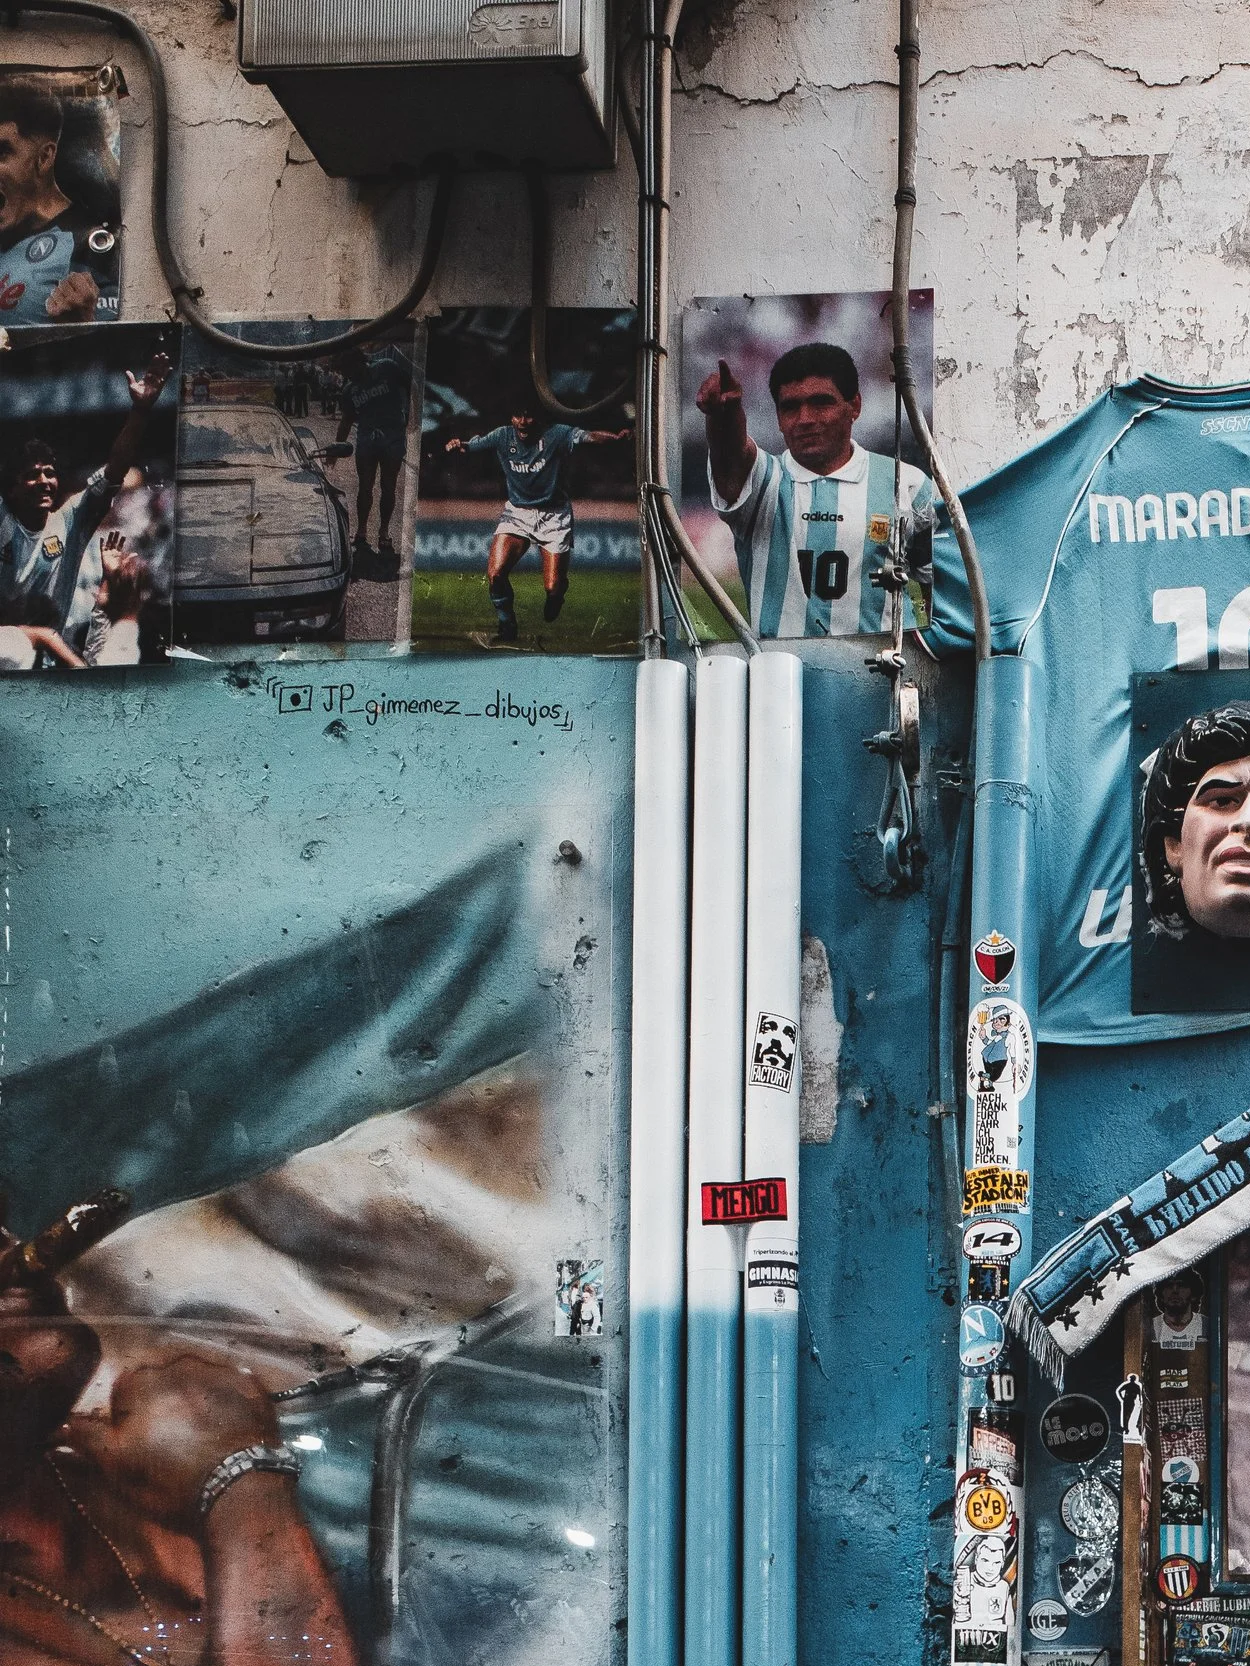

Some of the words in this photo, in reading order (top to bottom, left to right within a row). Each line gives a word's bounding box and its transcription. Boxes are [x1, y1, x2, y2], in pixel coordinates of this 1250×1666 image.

[515, 14, 556, 30] Enel
[801, 510, 844, 523] adidas
[798, 549, 850, 601] 10
[750, 1064, 790, 1089] FACTORY
[976, 1093, 1002, 1103] NACH
[976, 1102, 1008, 1112] FRANK
[976, 1111, 999, 1120] FURT
[975, 1120, 1000, 1129] FAHR
[975, 1137, 995, 1146] NUR
[975, 1146, 995, 1155] ZUM
[975, 1155, 1011, 1165] FICKEN.
[710, 1182, 780, 1219] MENGO
[972, 1231, 1014, 1249] 14
[963, 1308, 986, 1342] N
[991, 1373, 1015, 1402] 10
[972, 1492, 1001, 1517] BVB
